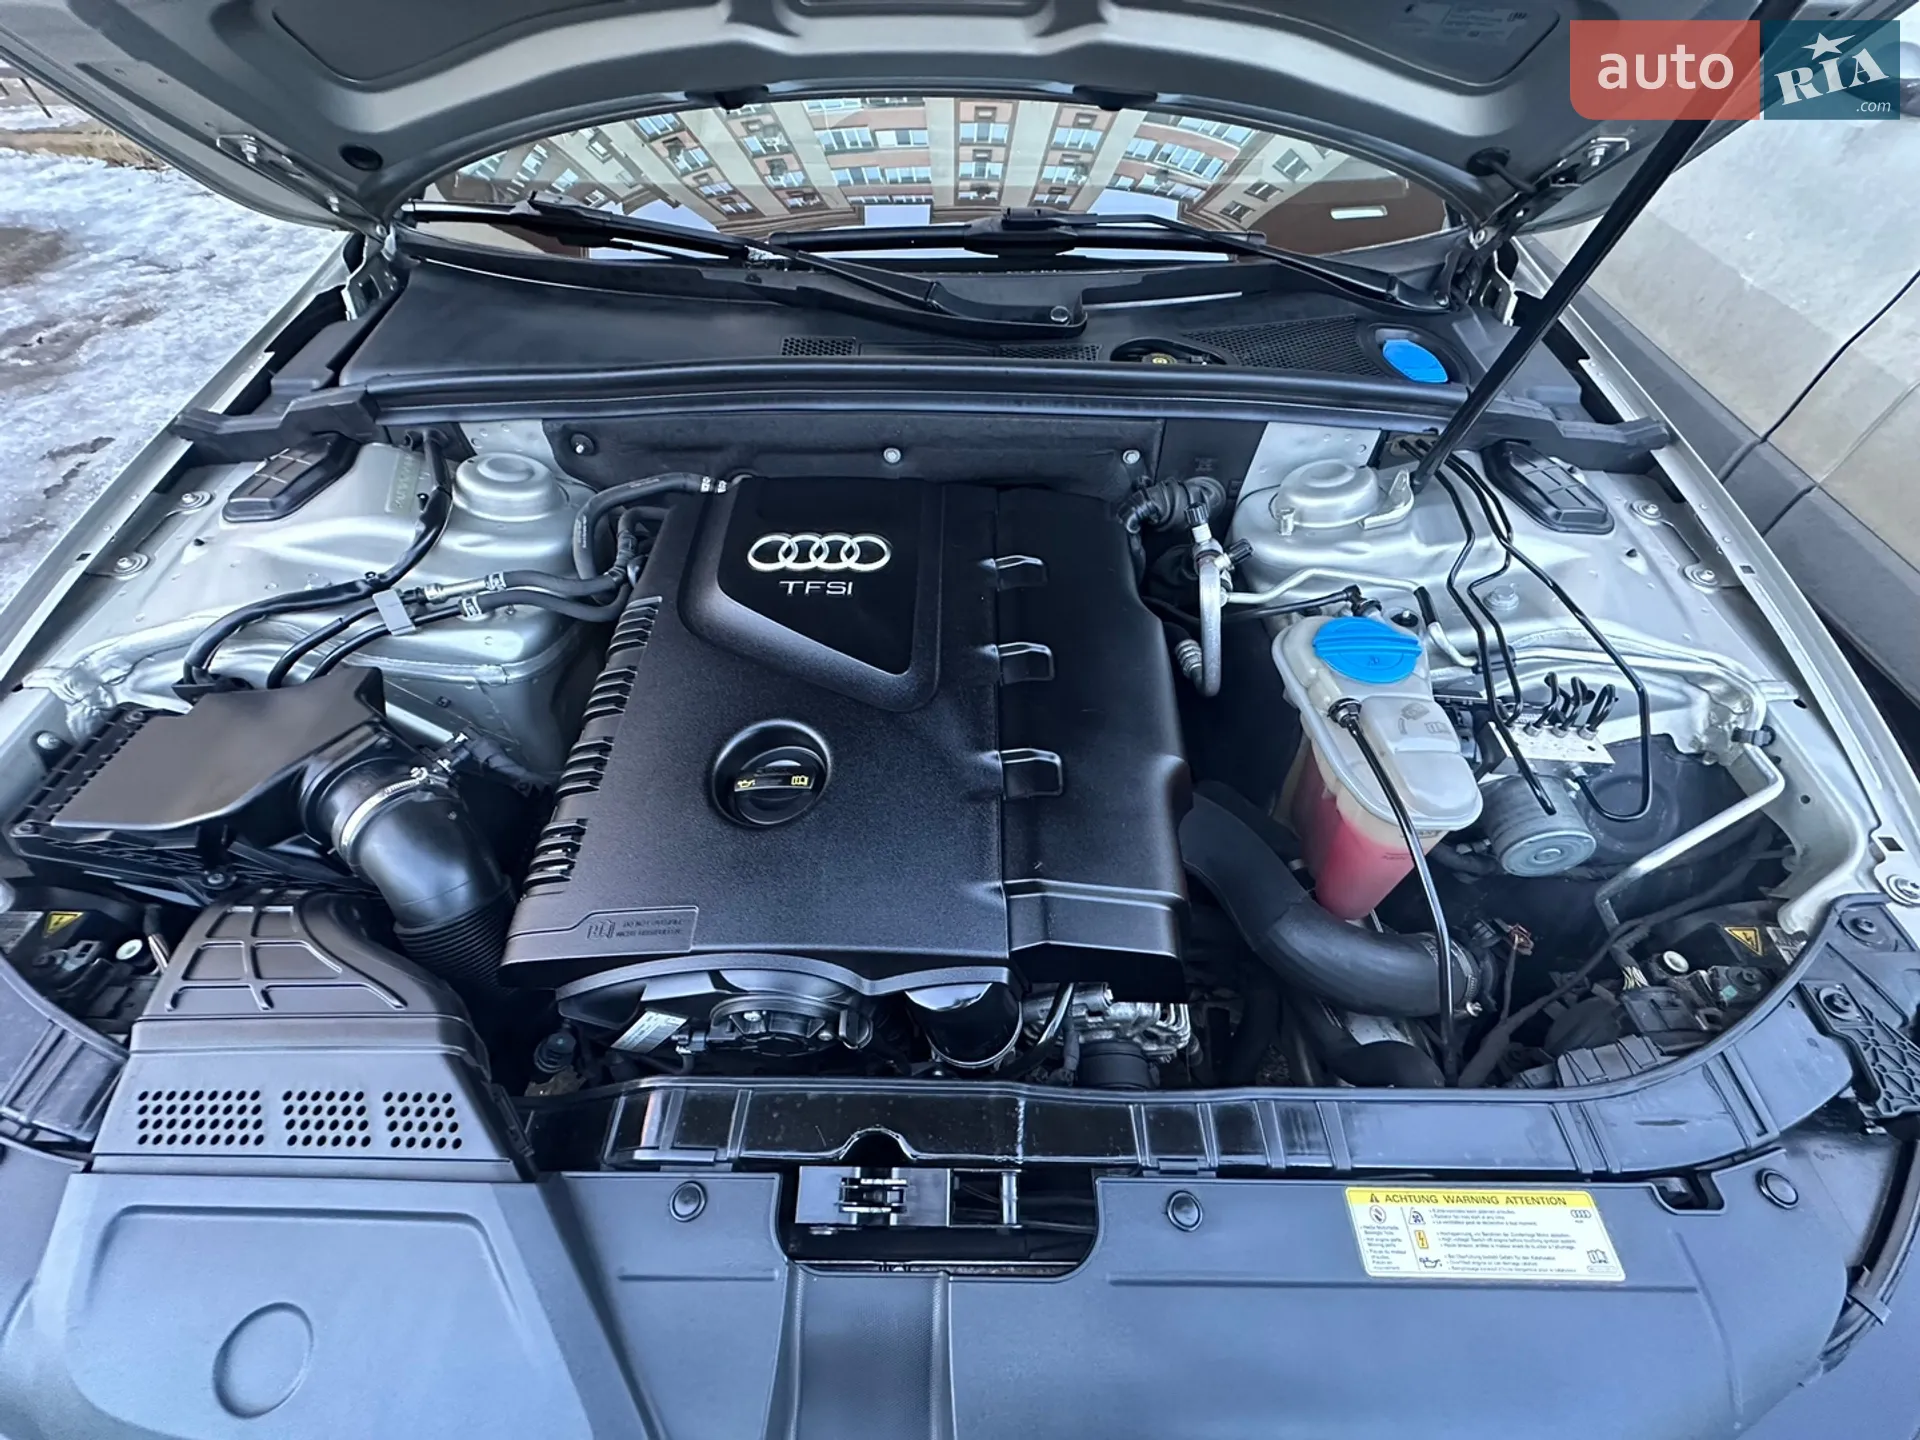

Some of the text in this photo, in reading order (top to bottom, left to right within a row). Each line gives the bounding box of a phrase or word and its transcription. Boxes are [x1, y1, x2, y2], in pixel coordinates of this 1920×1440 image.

[779, 580, 853, 596] TFSI
[1385, 1193, 1568, 1206] ACHTUNG WARNING ATTENTION
